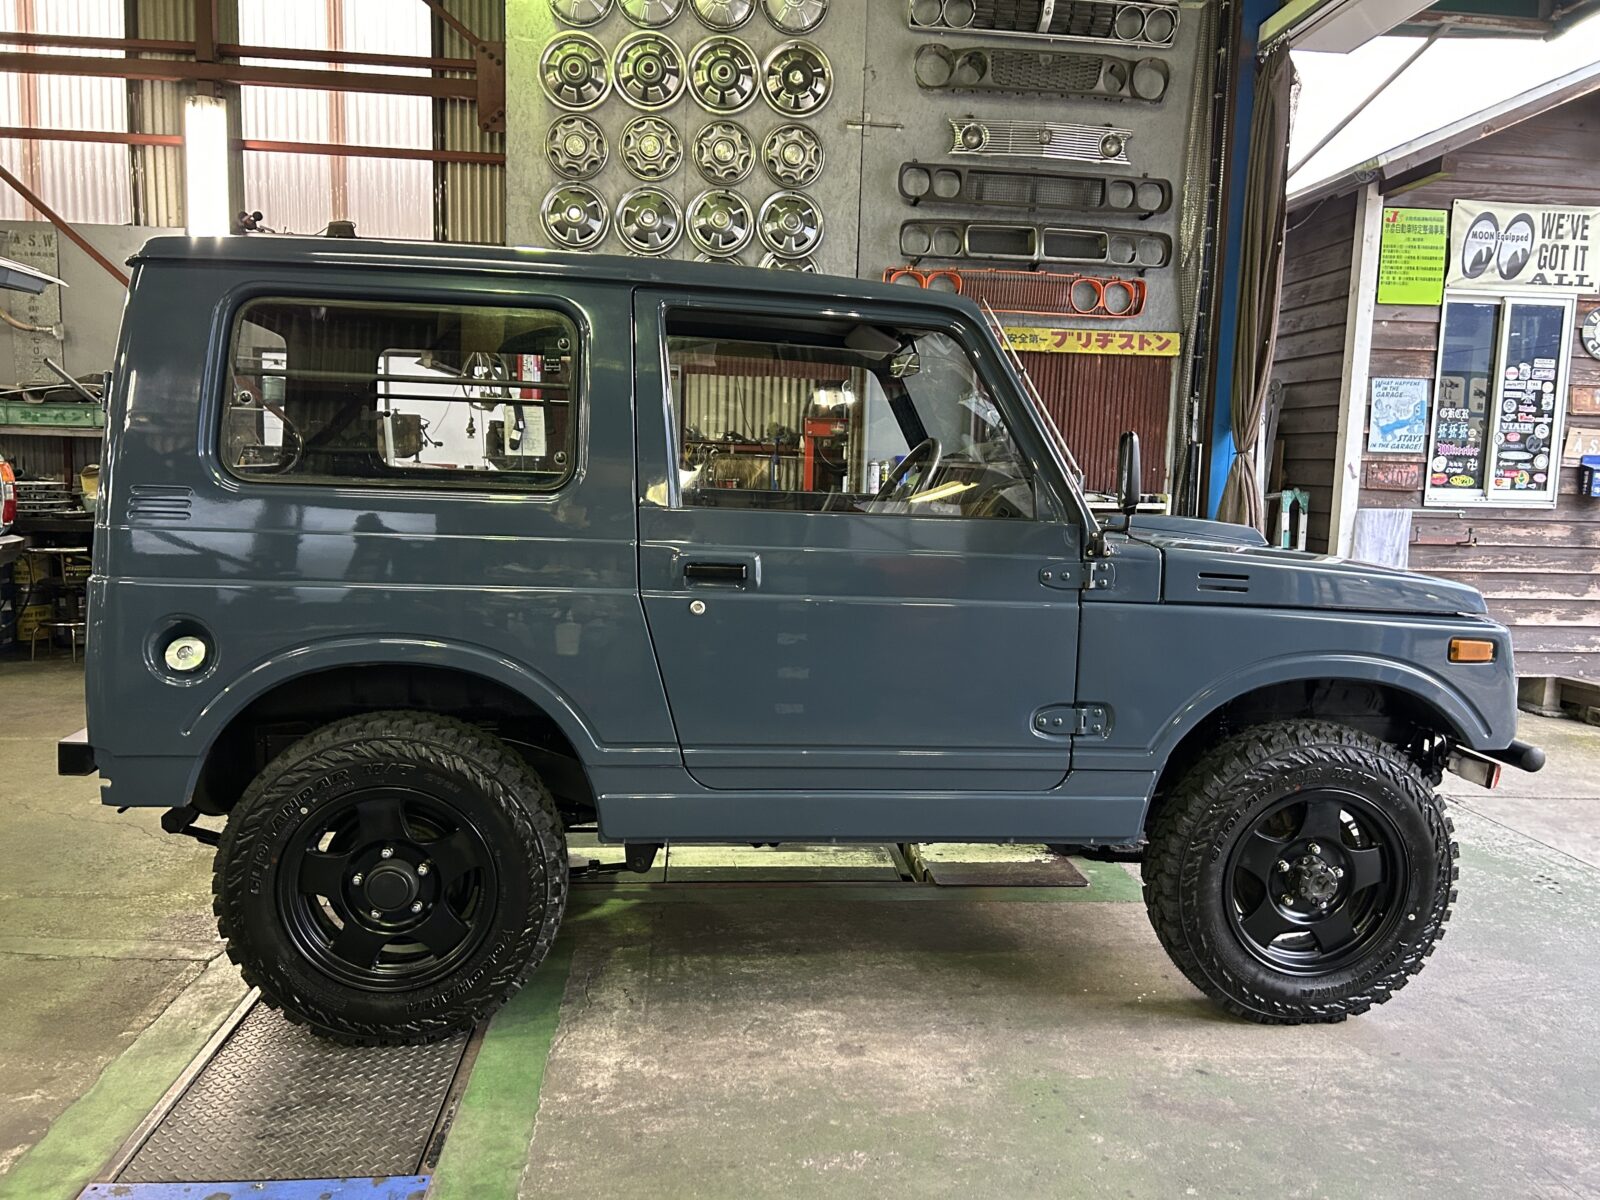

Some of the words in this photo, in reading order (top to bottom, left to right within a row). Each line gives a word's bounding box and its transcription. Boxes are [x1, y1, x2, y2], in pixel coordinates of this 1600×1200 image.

[1541, 212, 1590, 241] WE'VE
[1471, 230, 1495, 240] MOON
[1496, 231, 1529, 243] Equipped
[1537, 243, 1570, 271] GOT
[1573, 245, 1589, 272] IT
[1525, 272, 1594, 288] ALL
[1007, 333, 1049, 344] 安全第一
[1050, 331, 1172, 351] ブリヂストン
[1375, 380, 1394, 389] WHAT
[1397, 434, 1423, 442] STAYS
